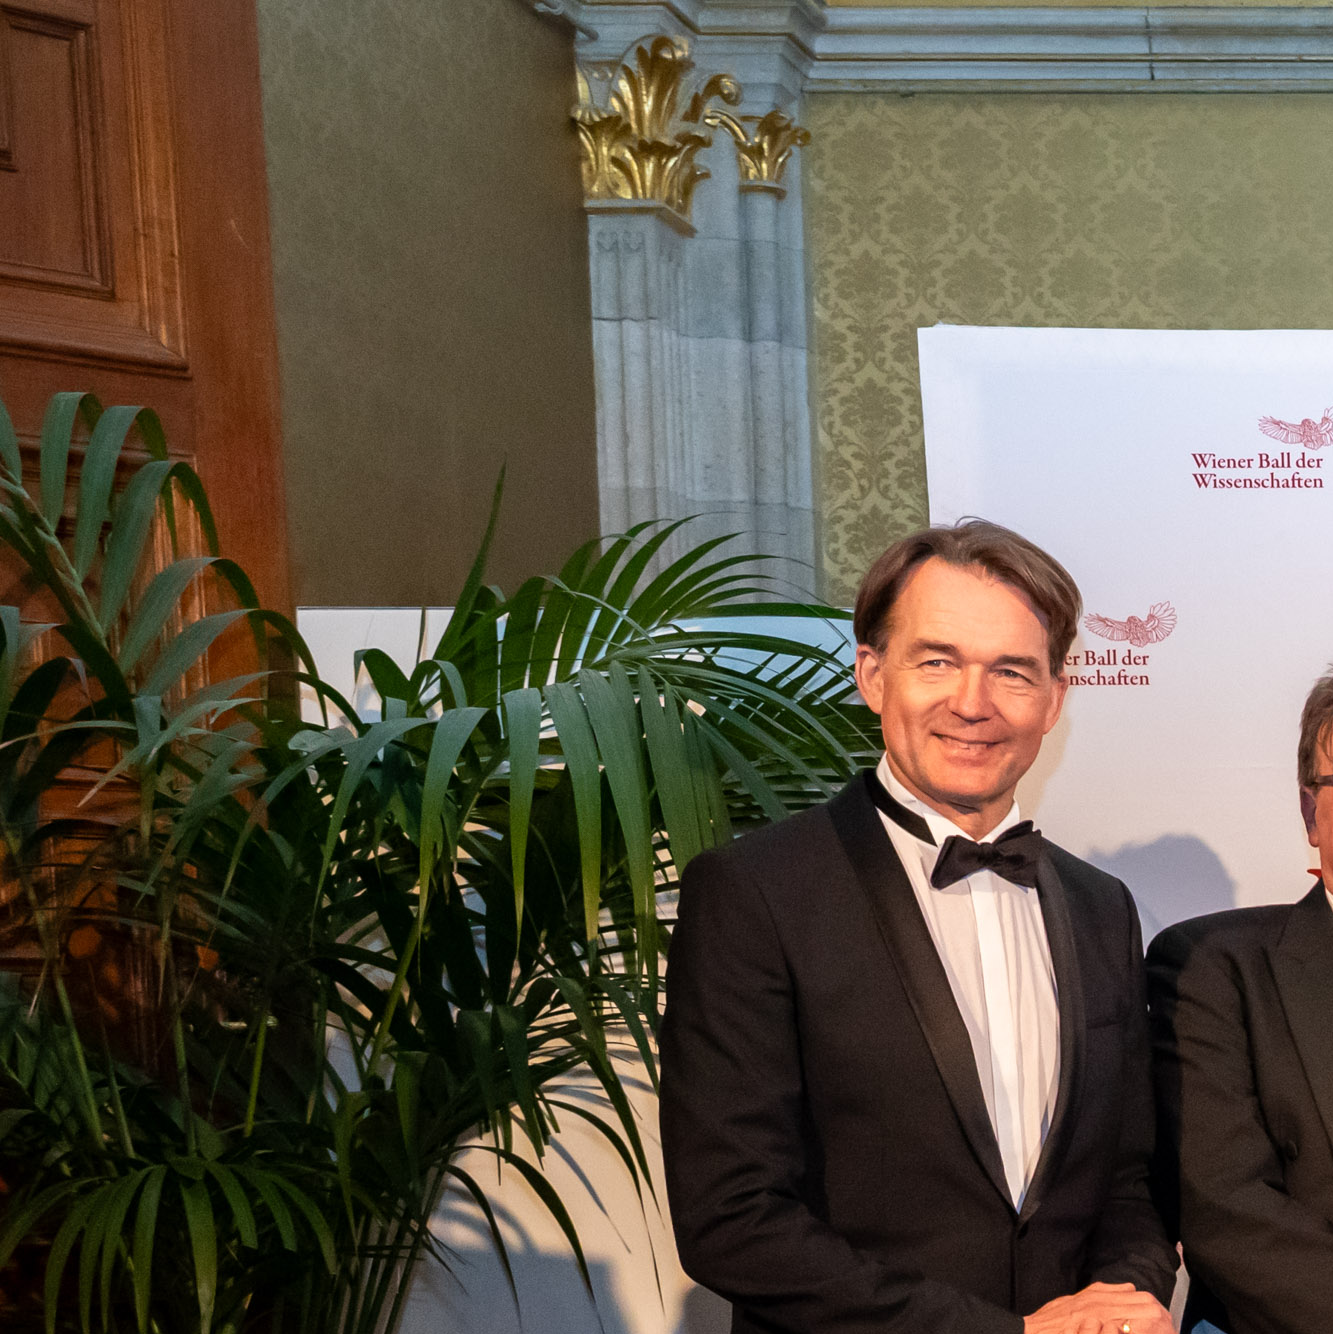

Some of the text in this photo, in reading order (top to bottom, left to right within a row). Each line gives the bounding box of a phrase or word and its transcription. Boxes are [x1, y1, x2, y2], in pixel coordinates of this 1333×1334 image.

[1192, 452, 1323, 468] Wiener Ball der
[1192, 472, 1324, 488] Wissenschaften
[1084, 650, 1117, 666] Ball
[1122, 650, 1150, 666] der
[1069, 669, 1150, 685] nschaften
